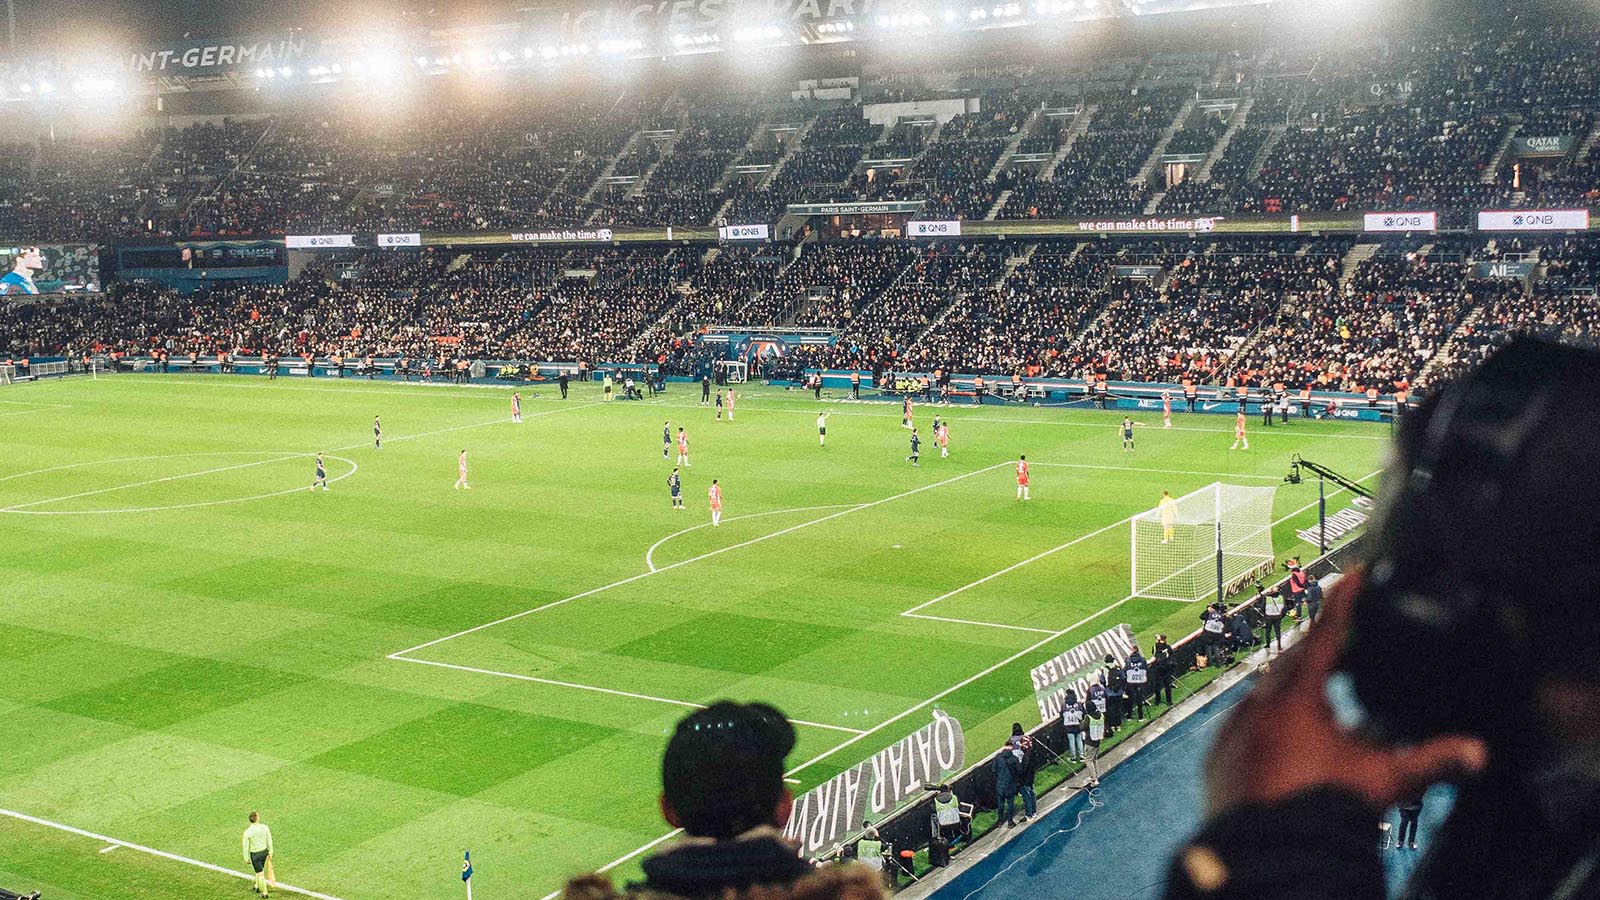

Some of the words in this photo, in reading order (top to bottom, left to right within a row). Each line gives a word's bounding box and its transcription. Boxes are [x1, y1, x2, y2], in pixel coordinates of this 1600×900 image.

[131, 39, 306, 71] INT-GERMAIN
[1527, 137, 1560, 147] QATAR
[1079, 222, 1094, 230] we
[1095, 222, 1114, 230] can
[1116, 219, 1146, 230] make
[1147, 218, 1165, 230] the
[1167, 219, 1194, 229] time
[1396, 216, 1421, 226] QNB
[1526, 215, 1553, 225] QNB
[740, 228, 760, 236] QNB
[929, 223, 948, 232] QNB
[395, 236, 410, 244] QNB
[540, 231, 561, 240] make
[563, 231, 576, 240] the
[577, 230, 596, 239] time
[1031, 640, 1104, 690] LIMITLESS
[871, 709, 956, 813] QATAR
[782, 762, 864, 859] AIRW
